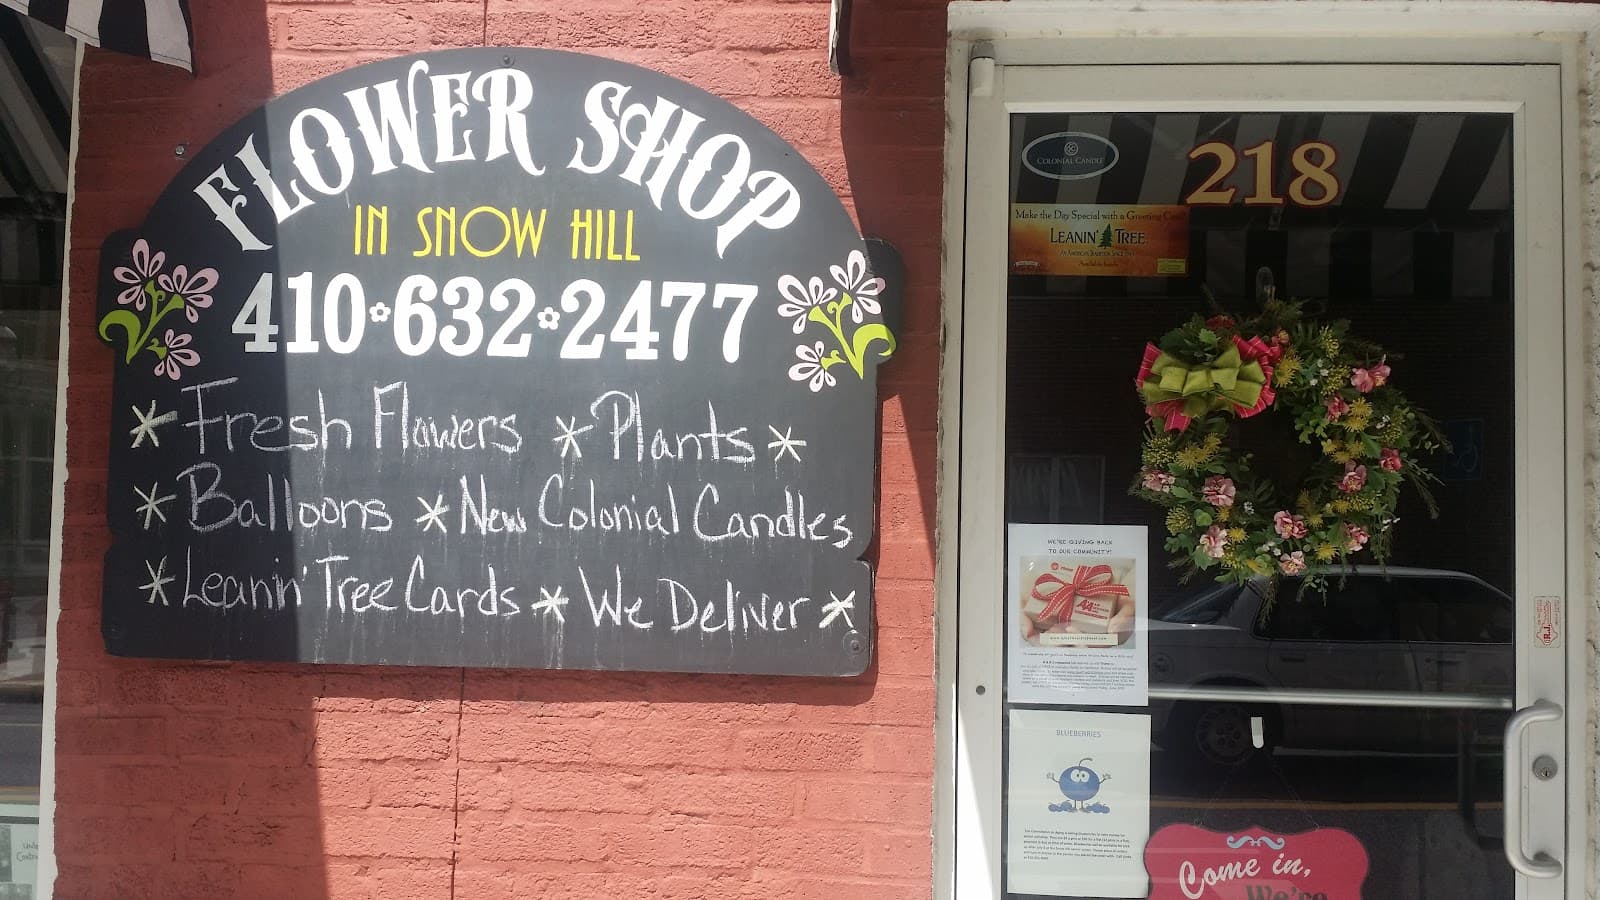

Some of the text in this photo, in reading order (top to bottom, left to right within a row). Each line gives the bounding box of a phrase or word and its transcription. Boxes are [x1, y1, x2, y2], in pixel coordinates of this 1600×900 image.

[193, 60, 801, 259] FLOWER SHOP
[1186, 141, 1340, 207] 218
[354, 205, 640, 261] IN SNOW HILL
[1015, 208, 1038, 220] Make
[1040, 209, 1052, 220] the
[1054, 209, 1070, 223] Day
[1071, 209, 1100, 222] Special
[1115, 228, 1145, 244] TREE
[181, 377, 756, 462] Fresh Flowers Plants
[176, 462, 854, 548] Balloons New Colonial Candles
[315, 554, 398, 614] Tree
[404, 554, 521, 617] Cards
[578, 564, 654, 630] We
[657, 577, 810, 633] Deliver
[1055, 728, 1102, 739] BLUEBERRIES
[1178, 852, 1312, 900] Come in,
